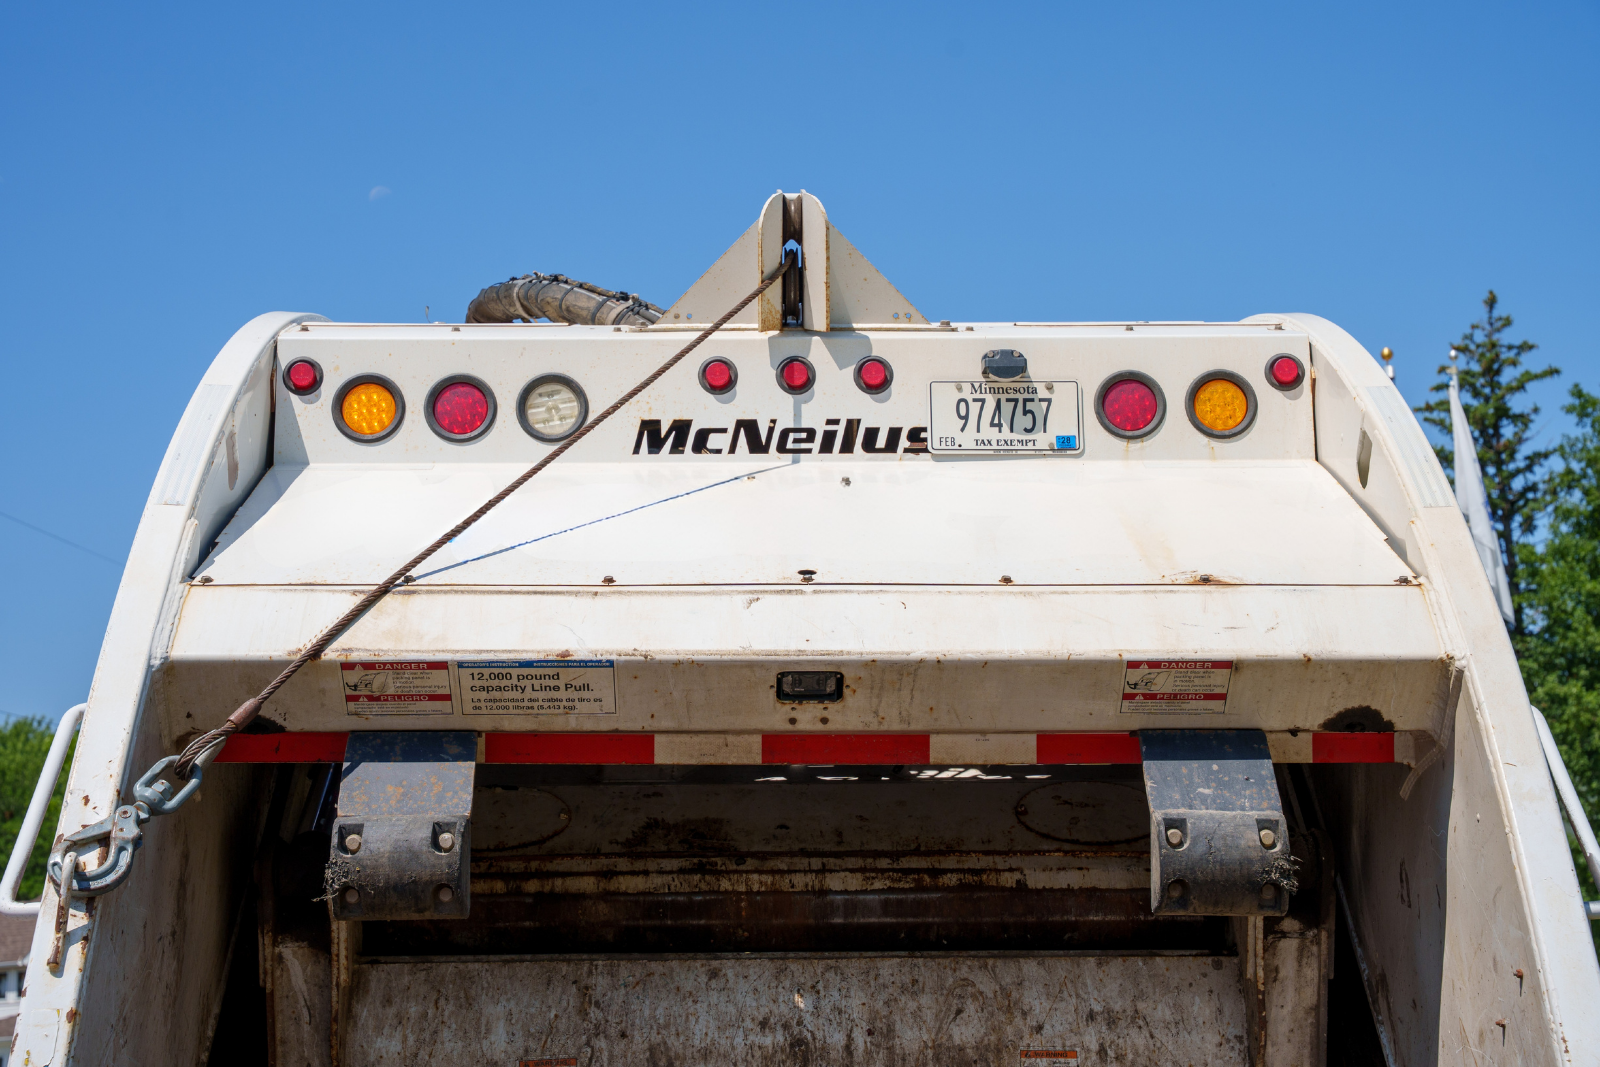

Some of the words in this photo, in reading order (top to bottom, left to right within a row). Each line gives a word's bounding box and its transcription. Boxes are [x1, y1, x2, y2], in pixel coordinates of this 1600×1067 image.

[970, 383, 1038, 395] Minnesota
[955, 398, 1053, 434] 974757
[632, 418, 931, 455] McNeilus
[1061, 436, 1071, 444] 28
[974, 439, 993, 447] TAX
[996, 439, 1038, 447] EXEMPT
[469, 672, 513, 682] 12,000
[517, 672, 560, 683] pound
[470, 684, 527, 694] capacity
[531, 683, 561, 692] Line
[564, 683, 594, 692] Pull.
[483, 697, 526, 705] capacidad
[563, 704, 579, 712] kg).
